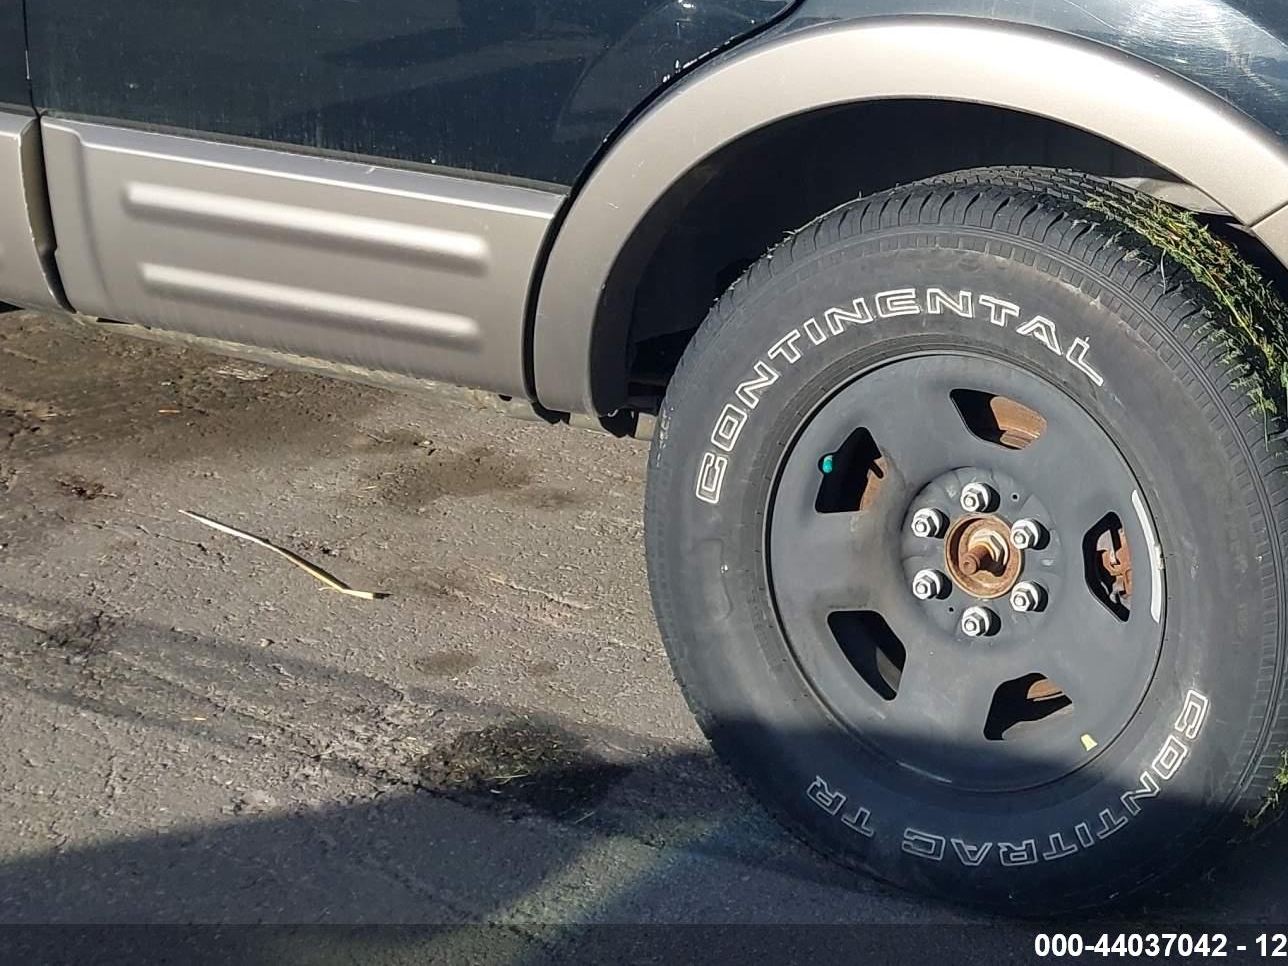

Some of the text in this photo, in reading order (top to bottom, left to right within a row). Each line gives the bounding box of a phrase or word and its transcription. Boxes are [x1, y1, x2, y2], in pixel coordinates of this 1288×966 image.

[696, 288, 1104, 504] CONTINENTAL
[806, 689, 1209, 867] CONTITRAC TR
